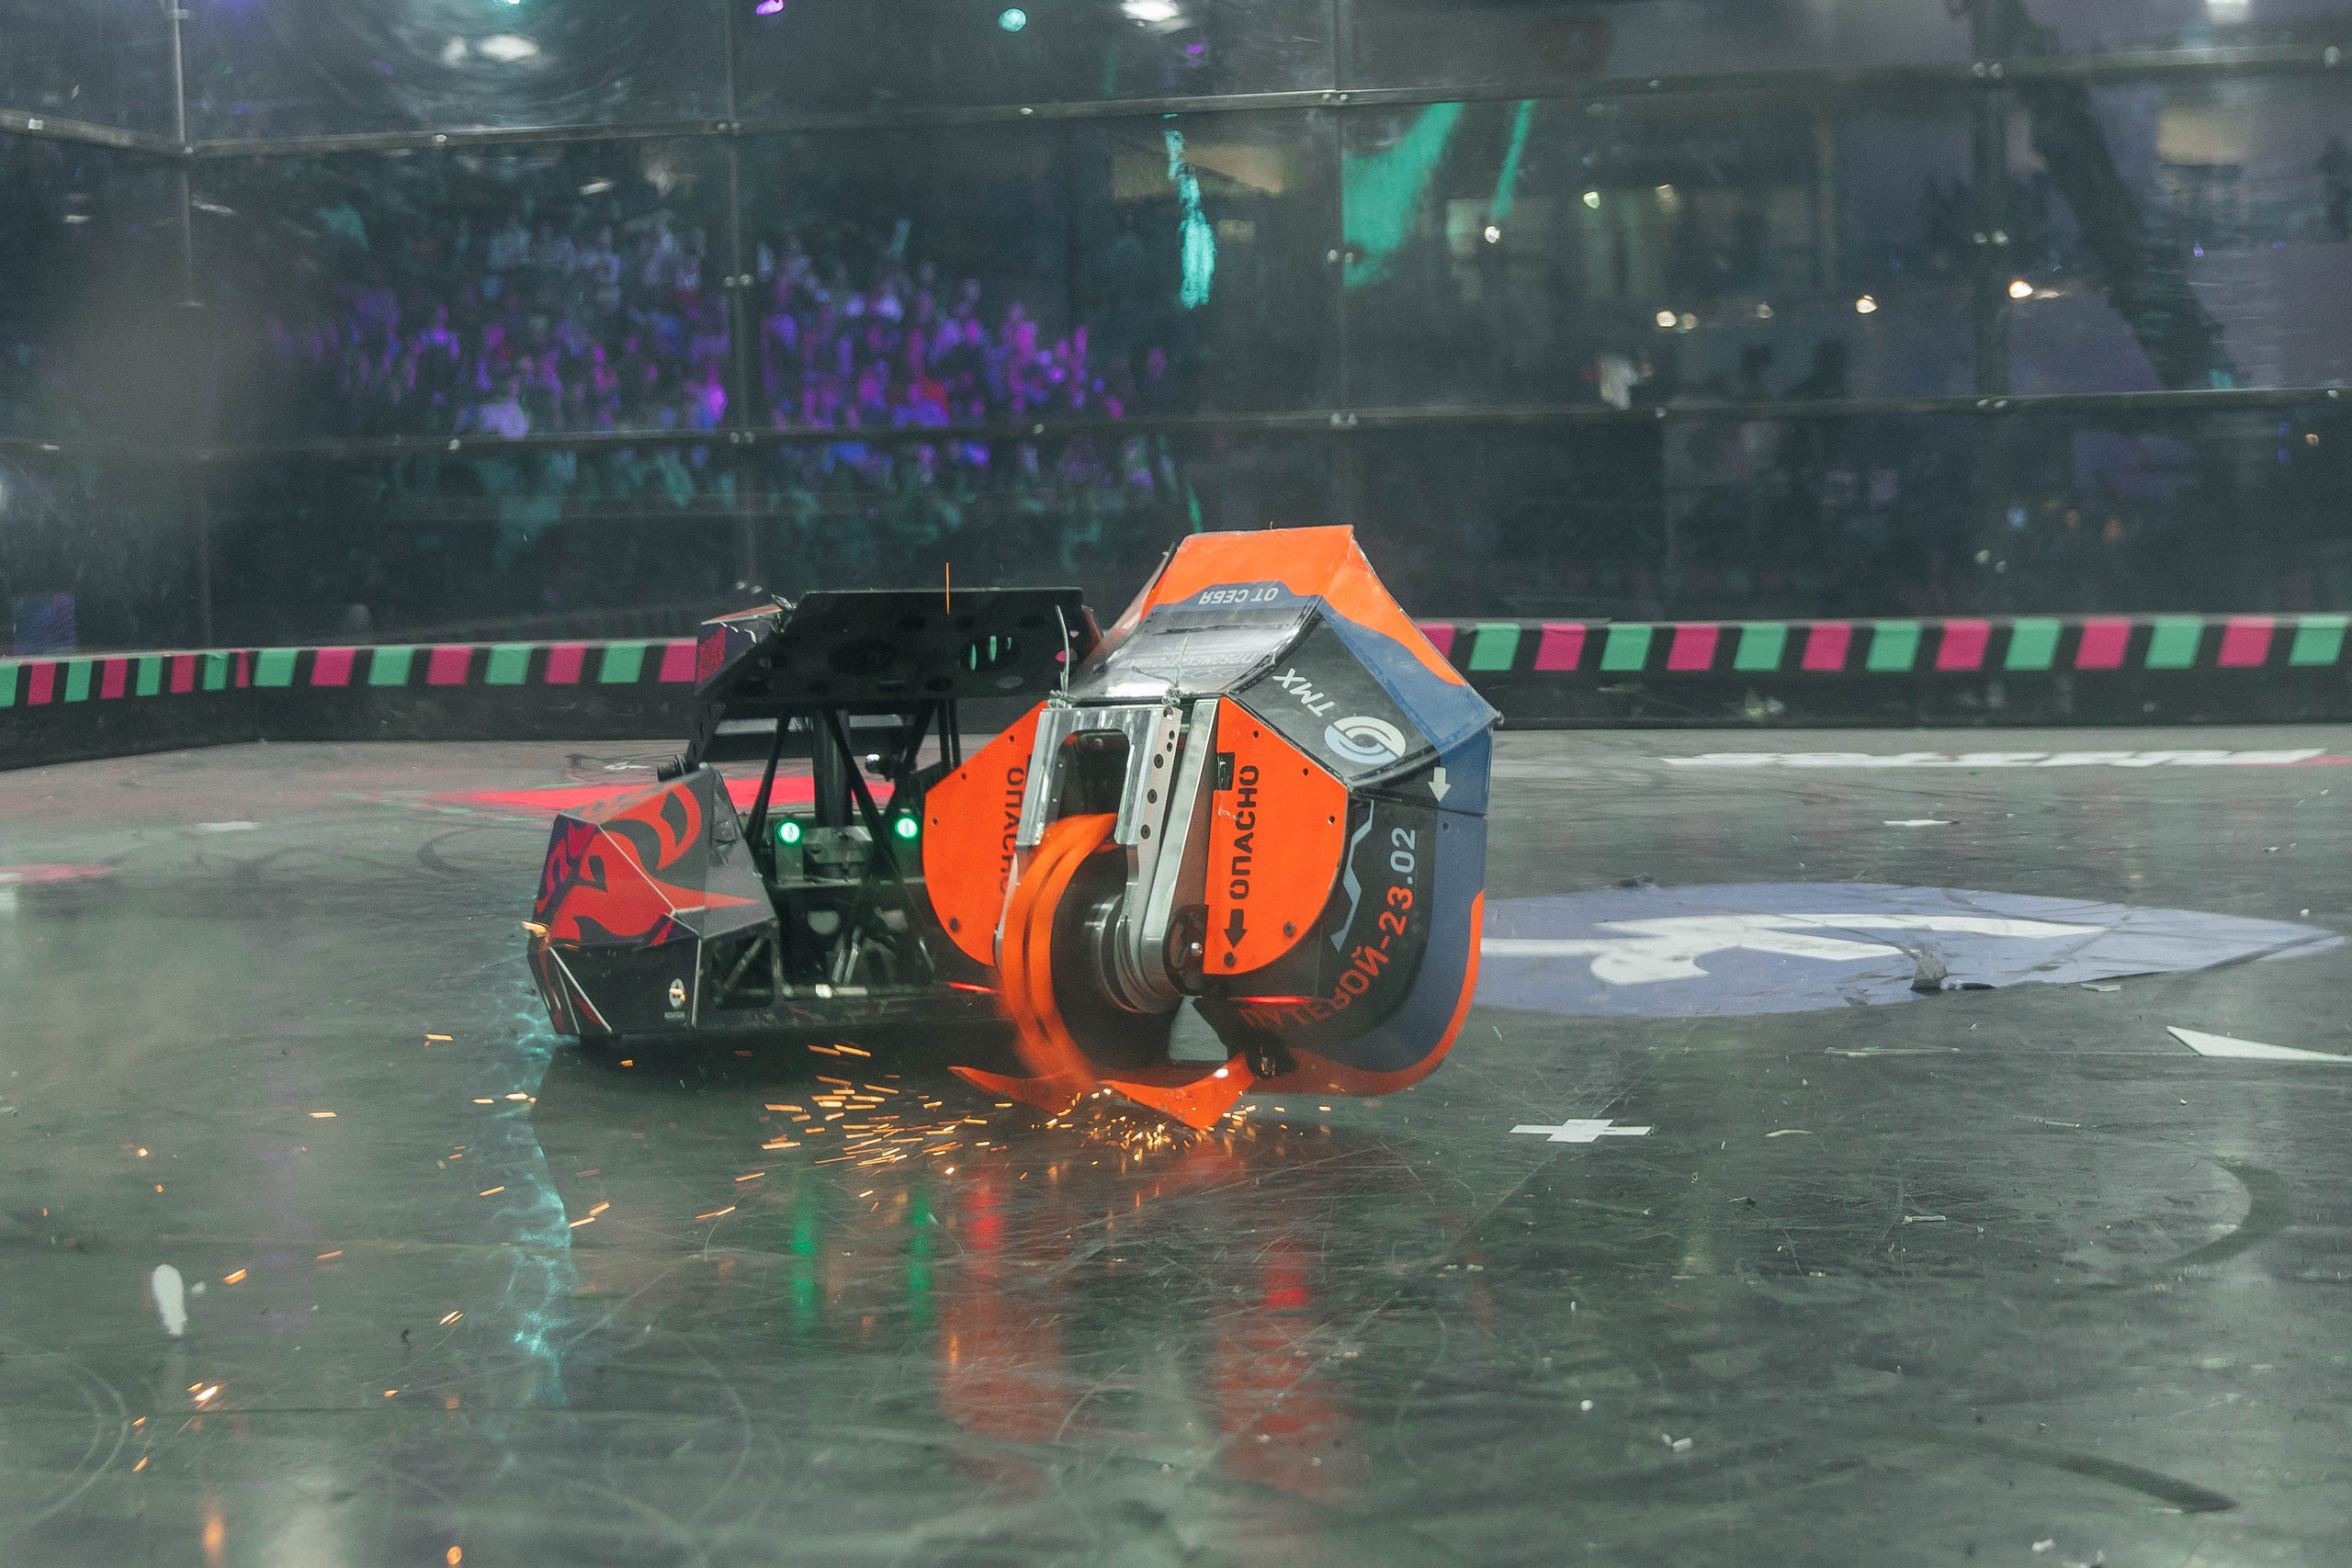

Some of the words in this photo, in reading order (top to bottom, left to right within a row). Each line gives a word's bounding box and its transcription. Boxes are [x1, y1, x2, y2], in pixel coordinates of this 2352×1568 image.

[1198, 589, 1250, 604] СЕБЯ
[1250, 588, 1279, 603] ОТ
[1272, 668, 1336, 717] ТМХ
[1229, 765, 1260, 900] ОПАСНО
